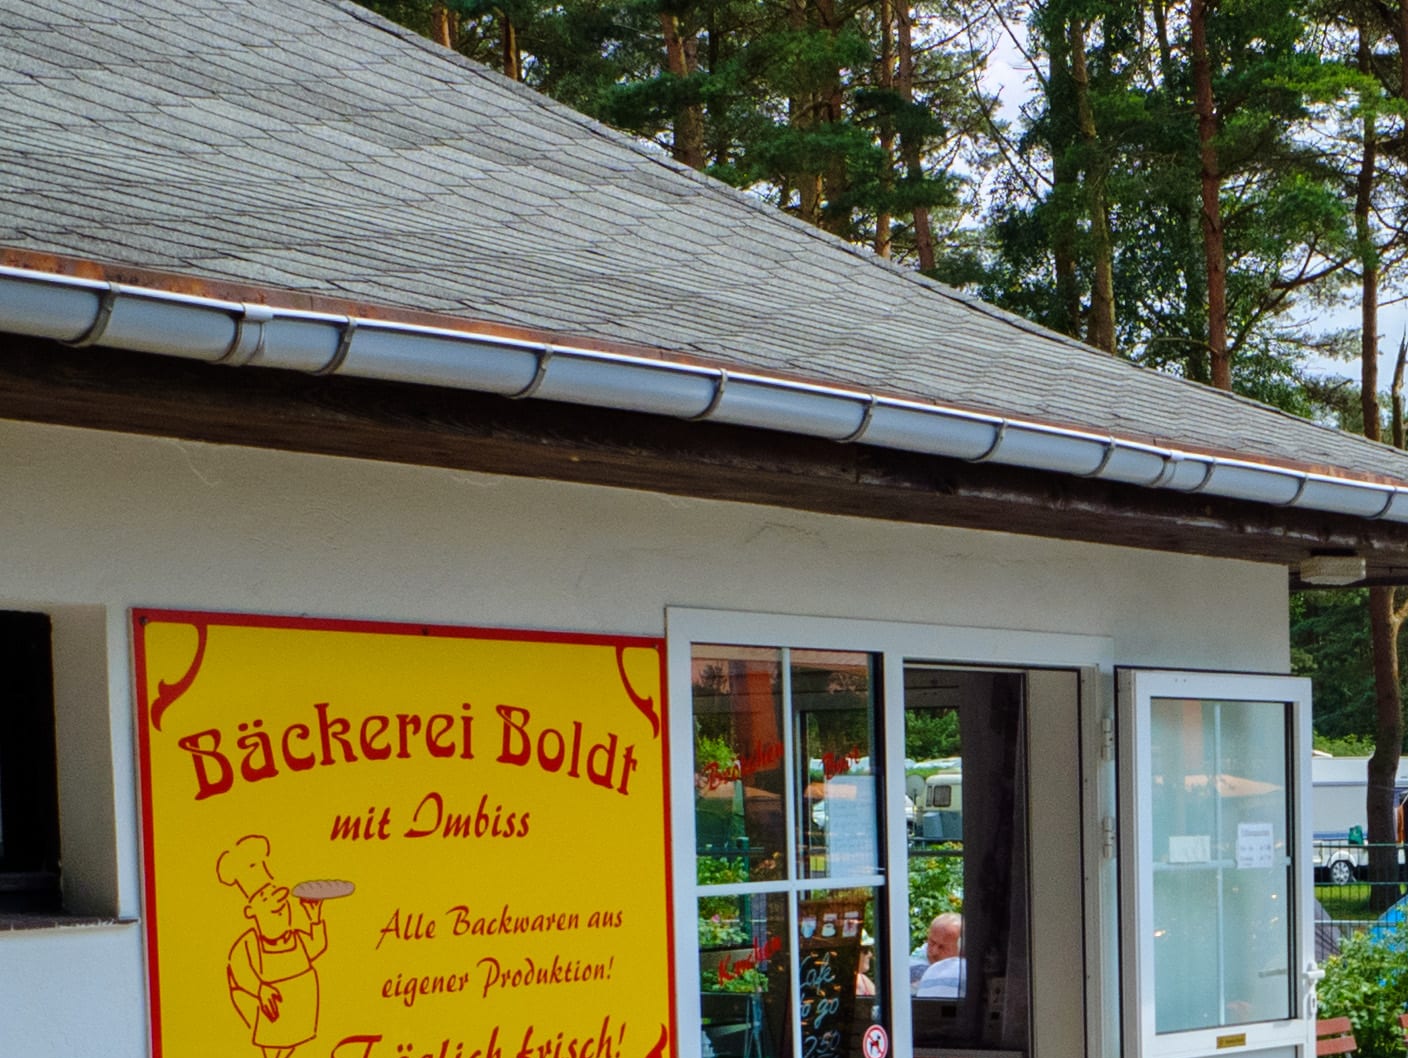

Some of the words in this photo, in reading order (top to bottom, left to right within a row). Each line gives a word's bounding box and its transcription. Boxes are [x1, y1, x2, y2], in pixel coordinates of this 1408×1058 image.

[178, 702, 475, 801] Bäckerei
[495, 704, 638, 796] Boldt
[330, 805, 391, 842] mit
[404, 791, 531, 840] Imbiss
[376, 908, 436, 950] Alle
[445, 905, 580, 939] Backwaren
[586, 908, 623, 931] aus
[381, 971, 469, 1007] eigener
[476, 957, 614, 998] Produktion!
[814, 998, 840, 1029] go
